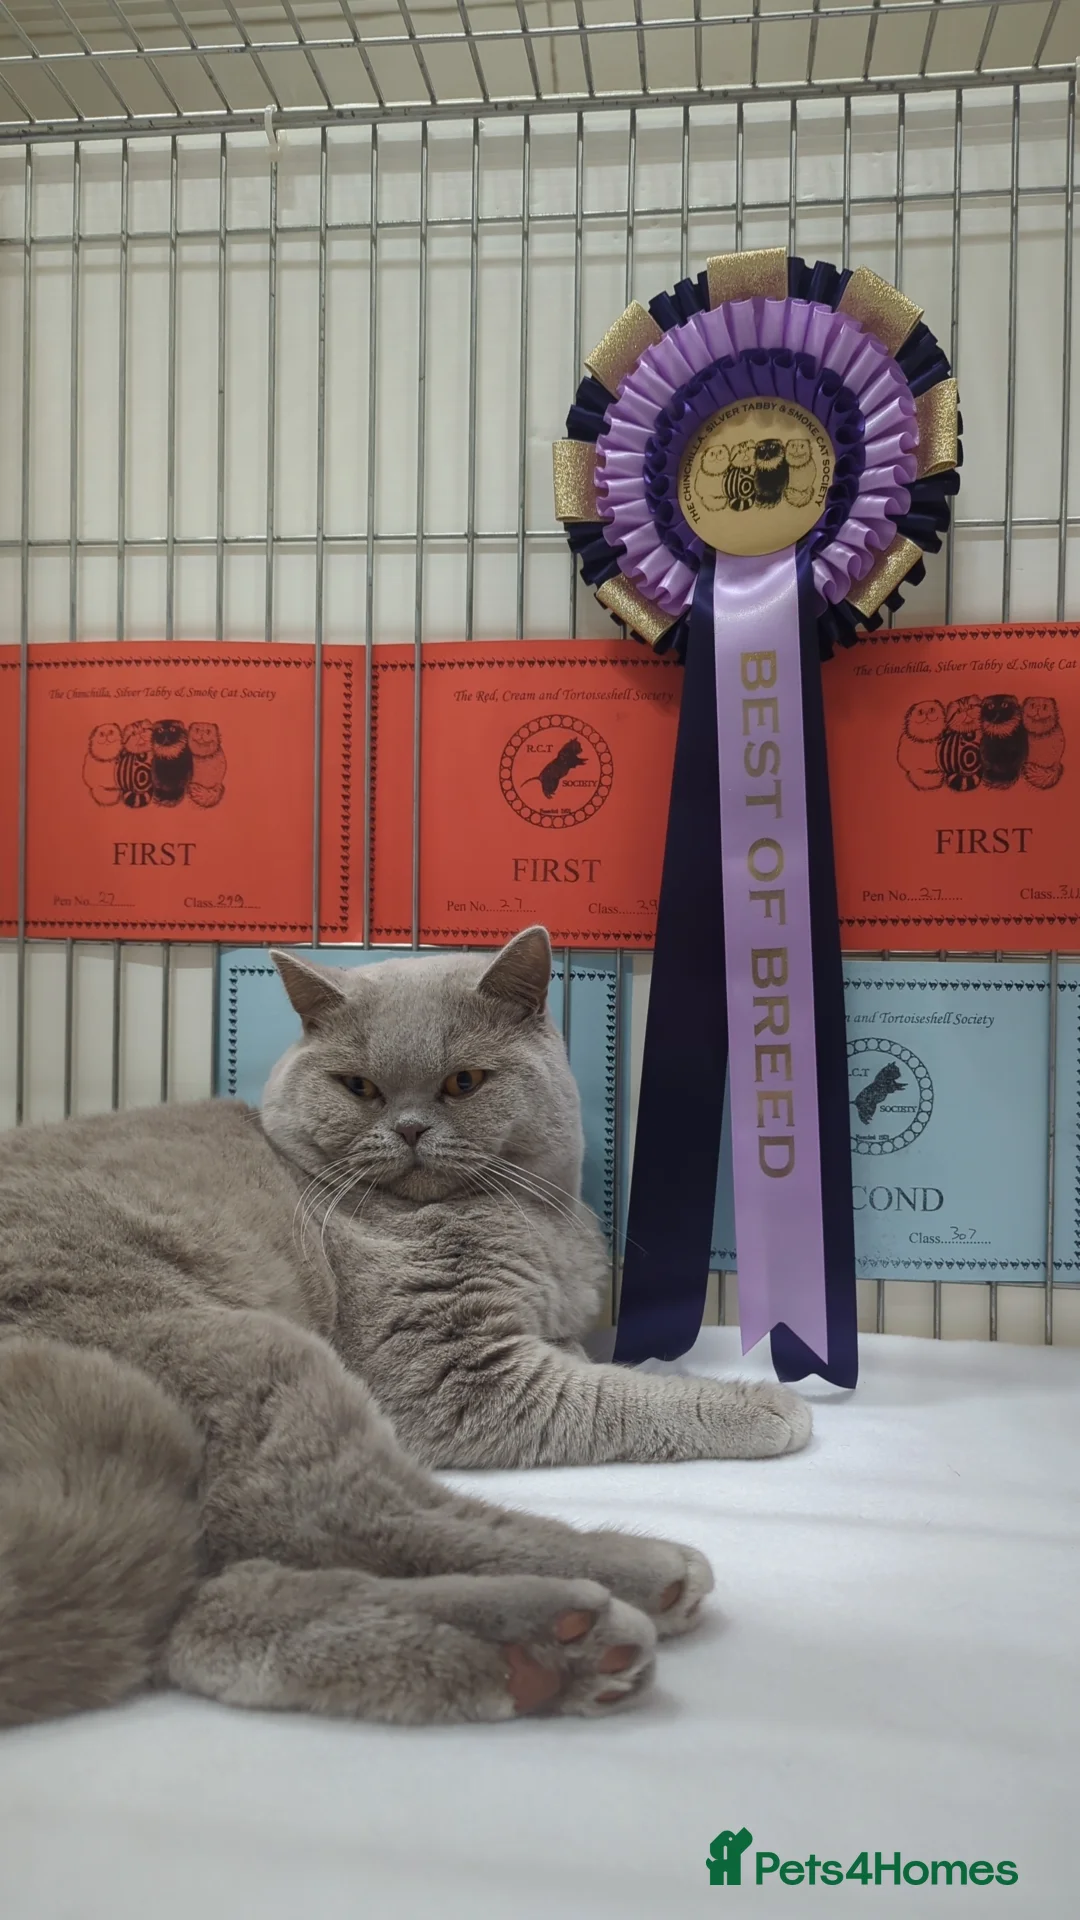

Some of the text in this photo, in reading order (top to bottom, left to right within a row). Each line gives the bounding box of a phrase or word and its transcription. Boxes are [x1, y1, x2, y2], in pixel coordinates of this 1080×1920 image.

[742, 402, 778, 412] TABBY
[779, 405, 787, 413] &
[706, 407, 740, 434] SILVER
[787, 408, 820, 437] SMOKE
[816, 436, 829, 457] CAT
[815, 458, 831, 508] SOCIETY
[687, 501, 701, 524] THE
[853, 657, 1077, 676] The Chinchilla, Silver Tabby & Smoke Cat
[114, 686, 142, 698] Silver
[142, 686, 171, 700] Tabby
[174, 686, 186, 698] &
[186, 686, 218, 699] Smoke
[220, 687, 238, 698] Cat
[240, 687, 276, 702] Society
[453, 687, 674, 704] The Red, Cream and Tortoiseshell Society
[562, 780, 598, 788] SOCIETY
[936, 827, 1033, 855] FIRST
[112, 842, 196, 866] FIRST
[512, 858, 602, 883] FIRST
[53, 893, 71, 906] Pen
[862, 890, 884, 902] Pen
[447, 900, 466, 912] Pen
[739, 649, 796, 1179] BEST OF BREED
[853, 1011, 879, 1023] and
[879, 1010, 954, 1024] Tortoiseshell
[952, 1013, 995, 1029] Society
[880, 1105, 917, 1113] SOCIETY
